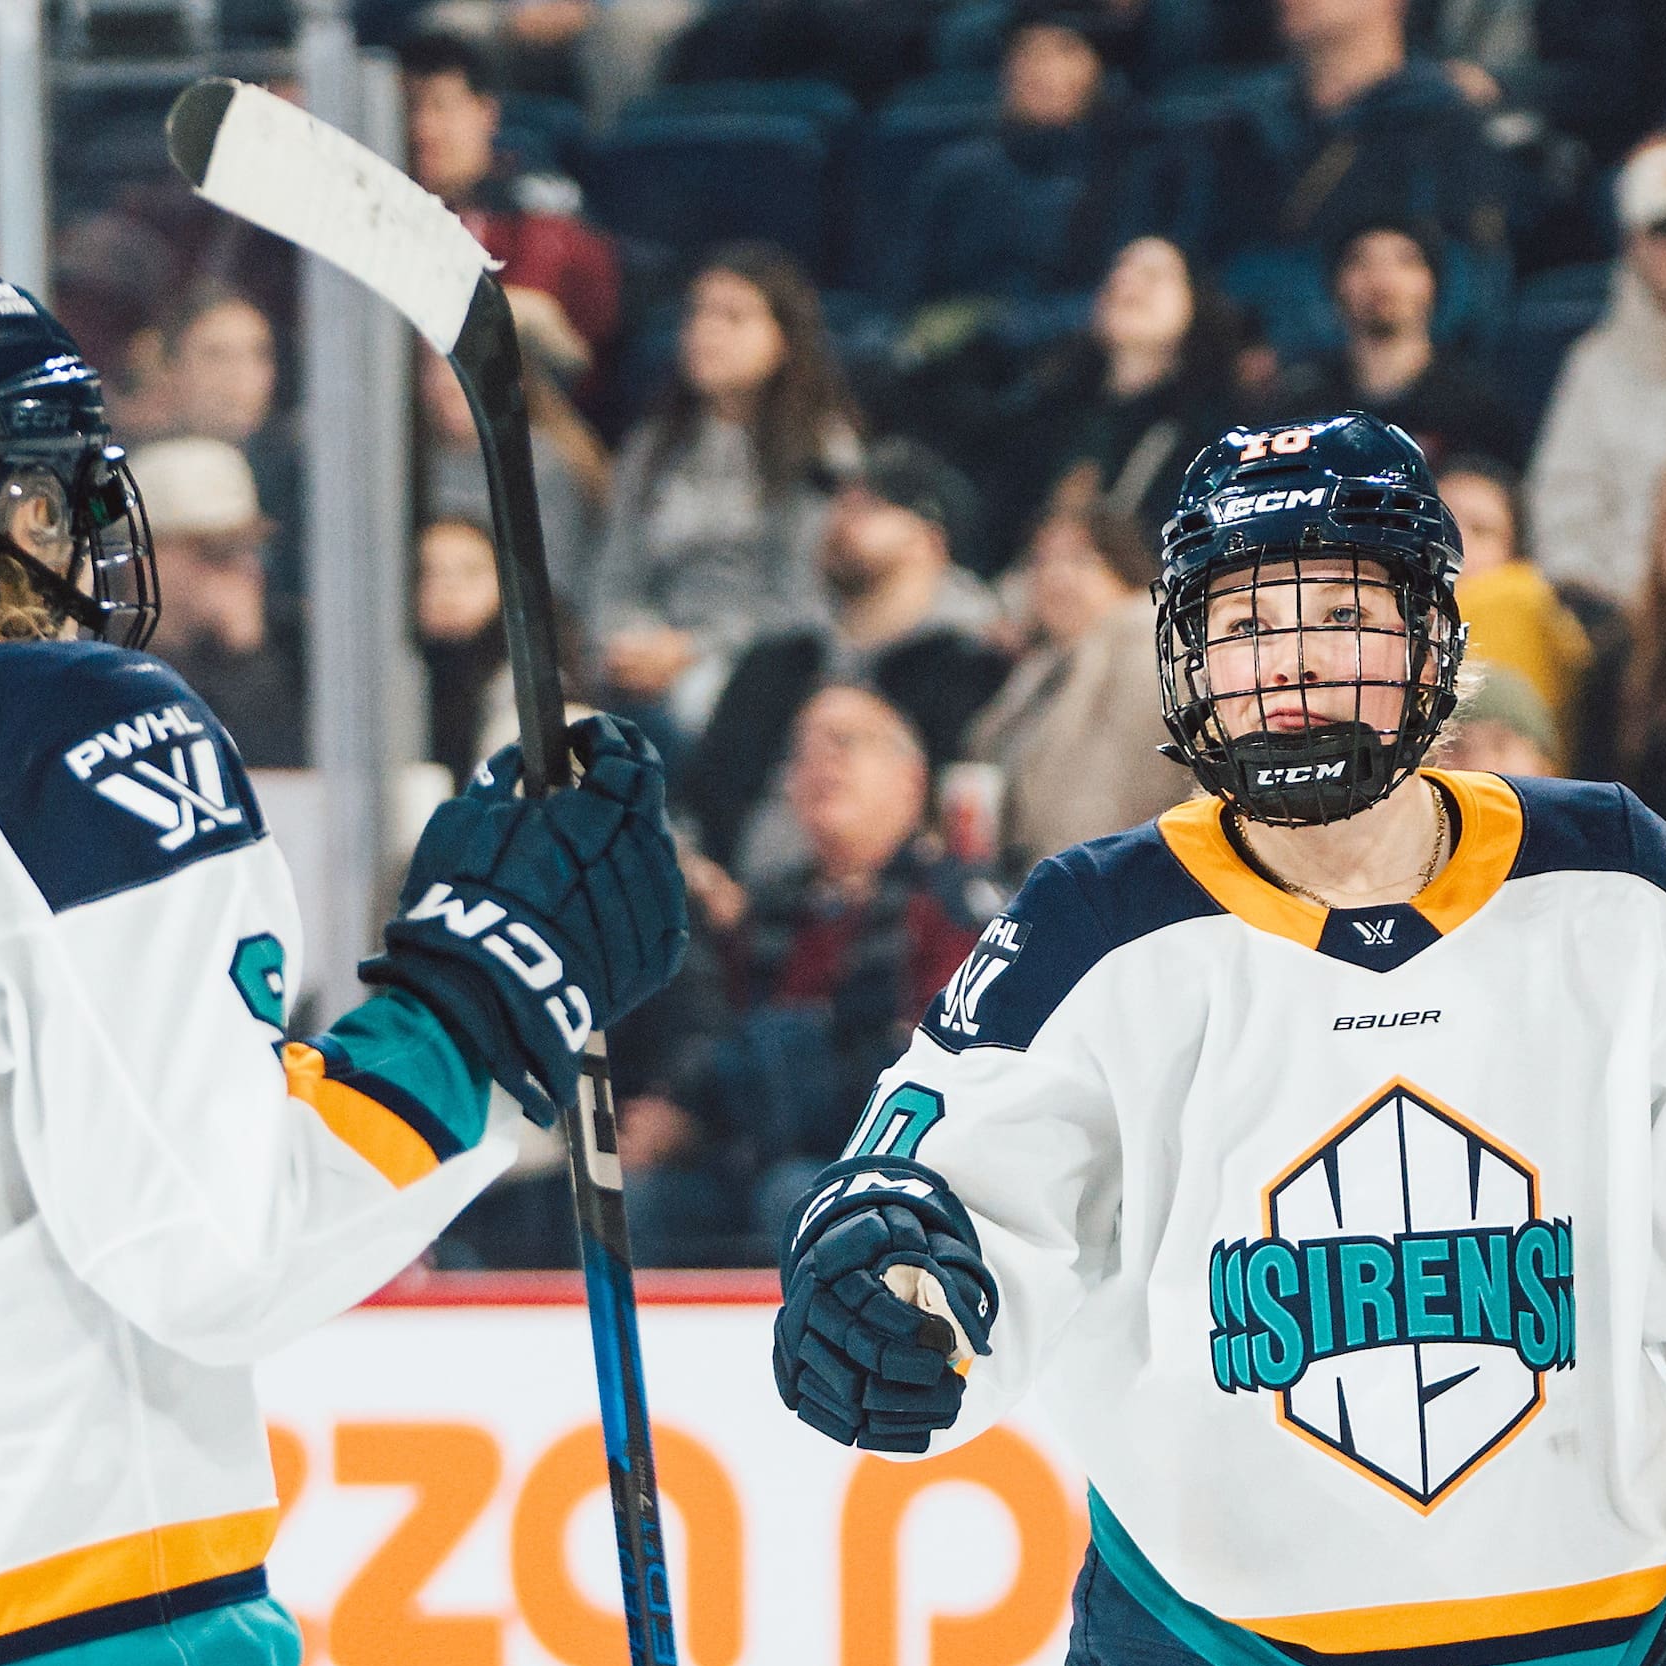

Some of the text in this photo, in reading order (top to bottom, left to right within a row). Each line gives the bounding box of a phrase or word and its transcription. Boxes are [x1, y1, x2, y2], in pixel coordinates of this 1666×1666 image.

[1240, 428, 1310, 462] 10
[1224, 486, 1328, 523] CCM
[64, 705, 205, 780] PWHL
[1257, 759, 1347, 786] CCM
[406, 882, 592, 1052] CCM
[1246, 1226, 1559, 1386] SIRENS
